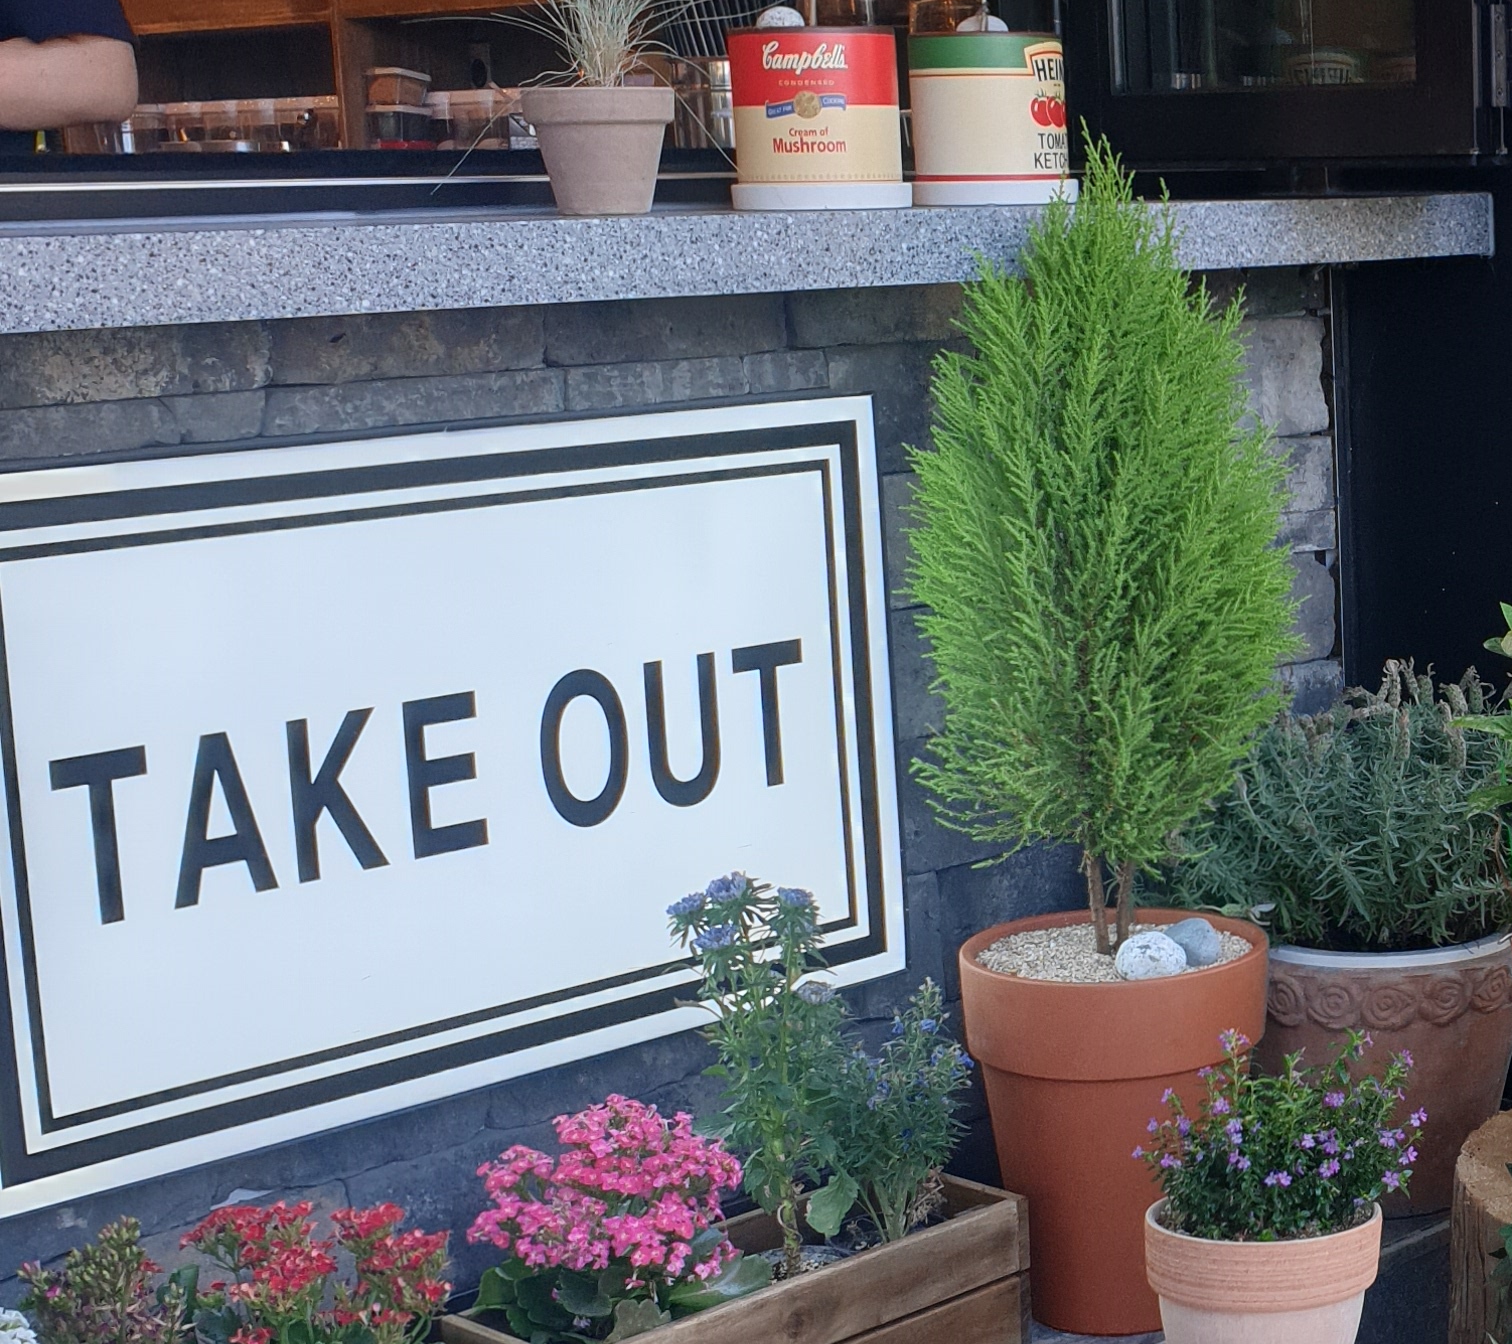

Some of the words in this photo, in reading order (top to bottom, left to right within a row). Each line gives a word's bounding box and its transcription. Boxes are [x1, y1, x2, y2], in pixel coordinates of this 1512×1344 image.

[763, 41, 848, 75] Campbell's
[788, 127, 818, 138] Cream
[820, 126, 829, 136] of
[772, 137, 847, 154] Mushroom
[49, 690, 490, 925] TAKE
[540, 638, 803, 829] OUT
